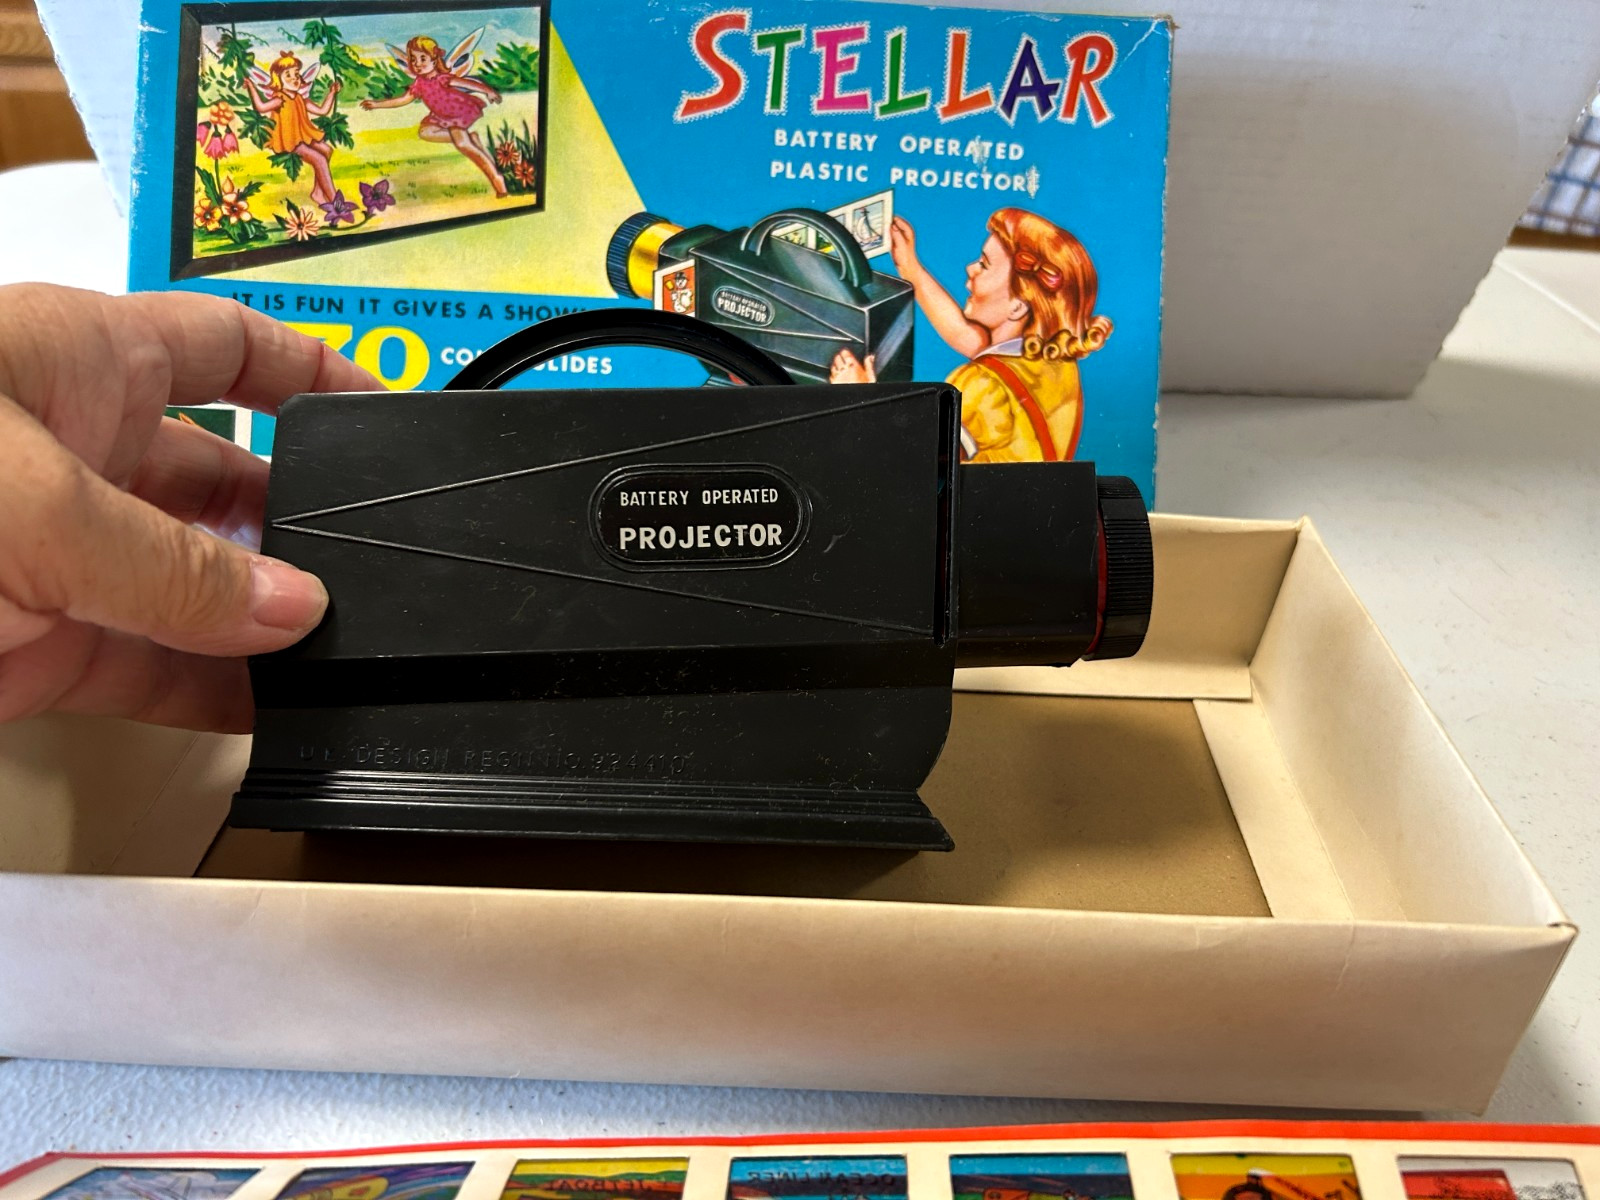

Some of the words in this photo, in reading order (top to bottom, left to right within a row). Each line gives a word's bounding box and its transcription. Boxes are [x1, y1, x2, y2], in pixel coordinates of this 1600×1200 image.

[673, 7, 1118, 128] STELLAR
[774, 129, 878, 154] BATTERY
[900, 134, 1024, 163] OPERATED
[770, 161, 869, 183] PLASTIC
[890, 168, 1028, 192] PROJECTOR
[266, 294, 285, 311] IS
[297, 297, 344, 314] FUN
[359, 299, 380, 315] IT
[394, 301, 465, 319] GIVES
[478, 304, 493, 320] A
[717, 297, 767, 323] PROJECTOR
[620, 490, 689, 507] BATTERY
[702, 488, 778, 505] OPERATED
[619, 523, 782, 550] PROJECTOR
[356, 746, 449, 767] DESIGN
